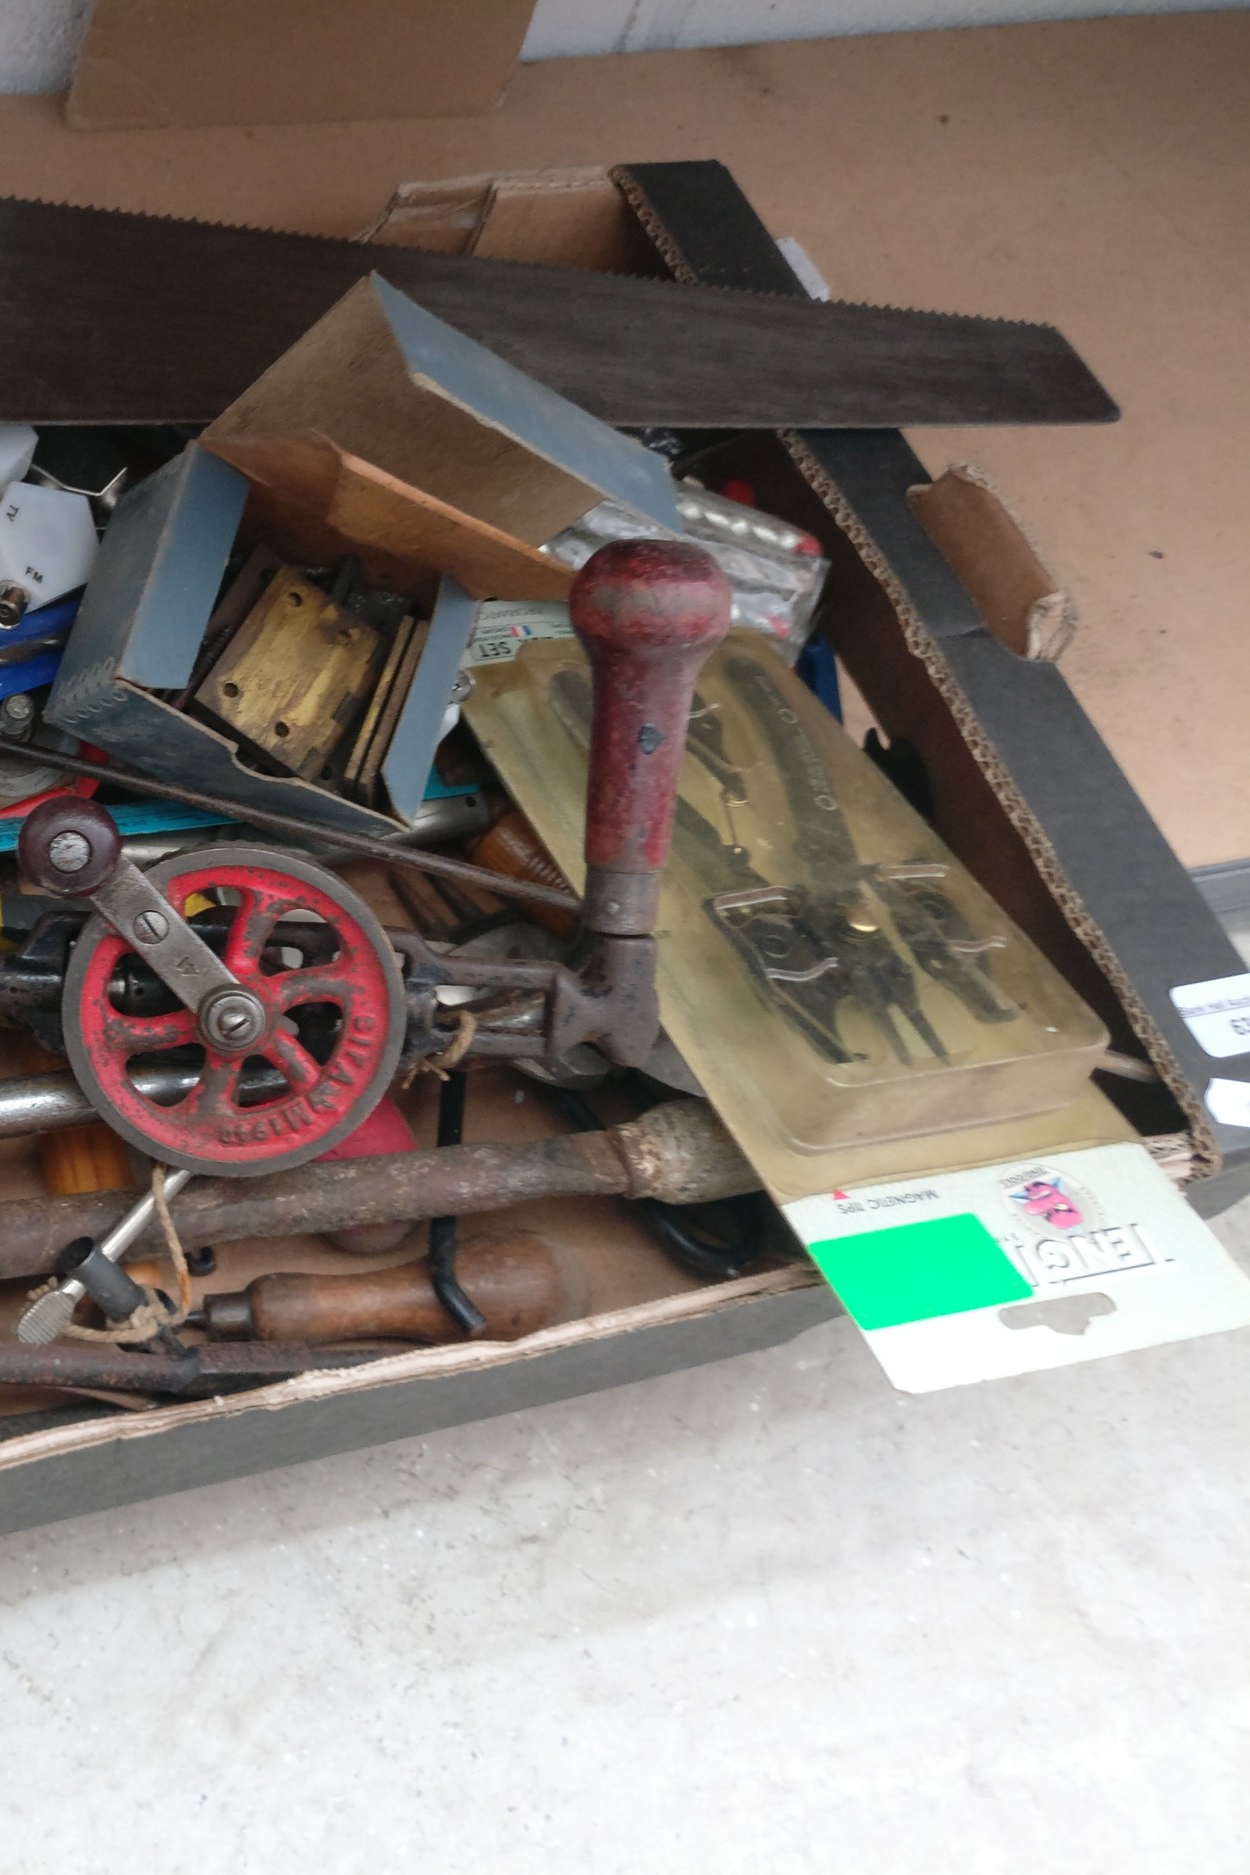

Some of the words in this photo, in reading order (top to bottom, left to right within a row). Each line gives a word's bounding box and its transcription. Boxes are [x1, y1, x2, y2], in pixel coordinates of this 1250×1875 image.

[6, 505, 19, 522] TV
[25, 566, 43, 584] FM
[478, 641, 511, 657] SET
[868, 1188, 939, 1212] MAGNETIC
